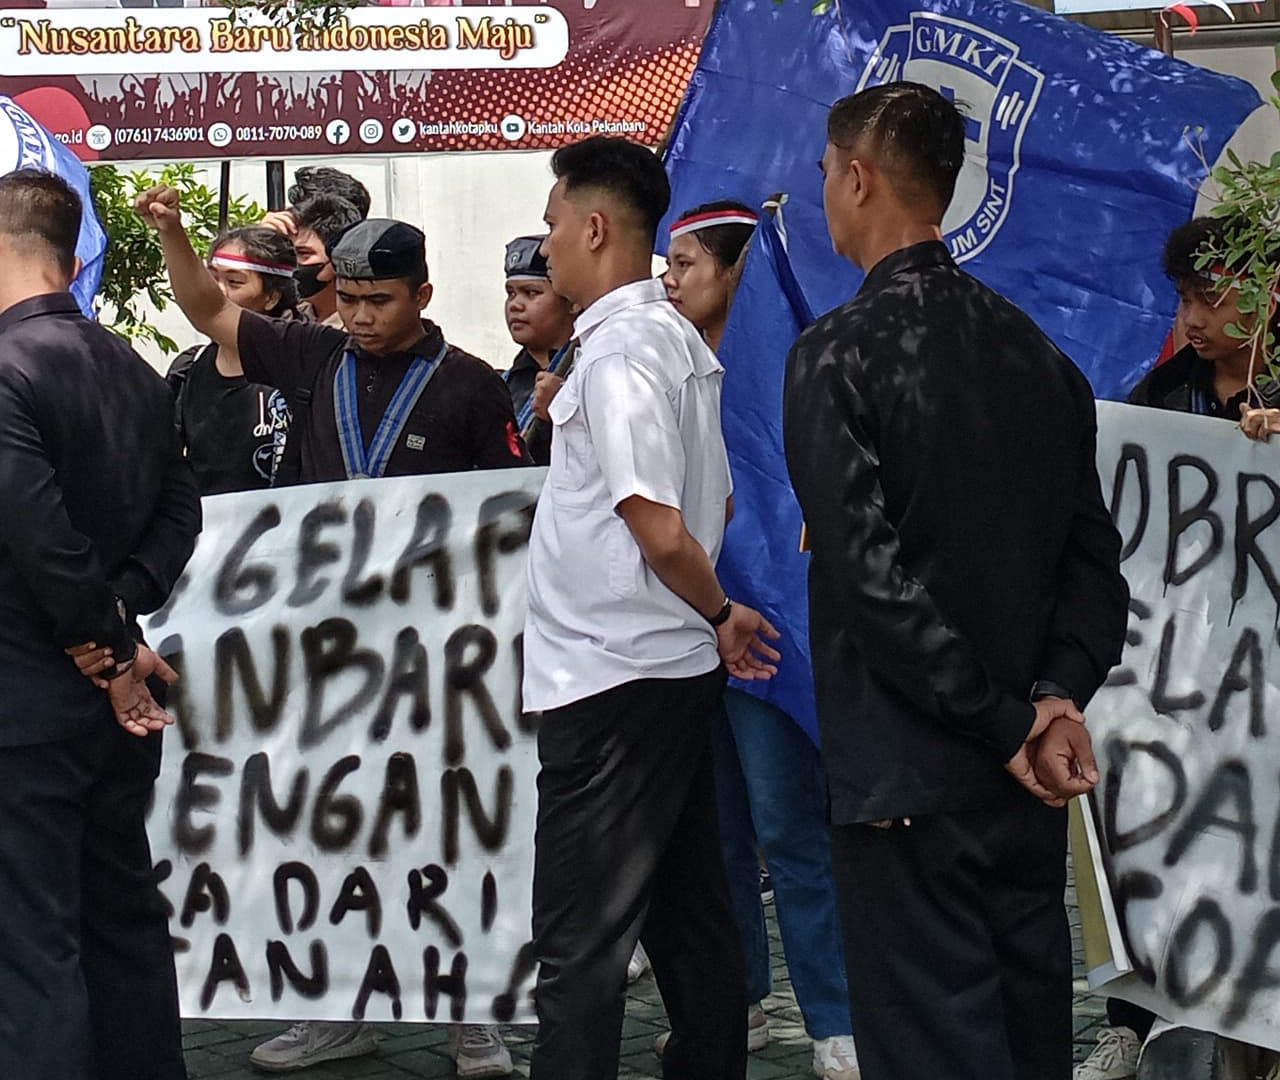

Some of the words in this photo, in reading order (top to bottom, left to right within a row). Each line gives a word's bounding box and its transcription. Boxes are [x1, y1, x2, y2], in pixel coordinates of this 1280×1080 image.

[209, 17, 291, 54] Baru
[916, 25, 1008, 76] GMKI
[115, 127, 152, 145] (0761)
[154, 127, 204, 143] 7436901
[236, 125, 321, 142] 0811-7070-089
[419, 121, 498, 136] kantahkotapku
[528, 121, 564, 135] Kantah
[567, 121, 590, 134] Kota
[592, 120, 646, 134] Pekanbaru
[977, 178, 1007, 234] SINT
[170, 751, 513, 866] ENGAN
[273, 859, 497, 948] DARI
